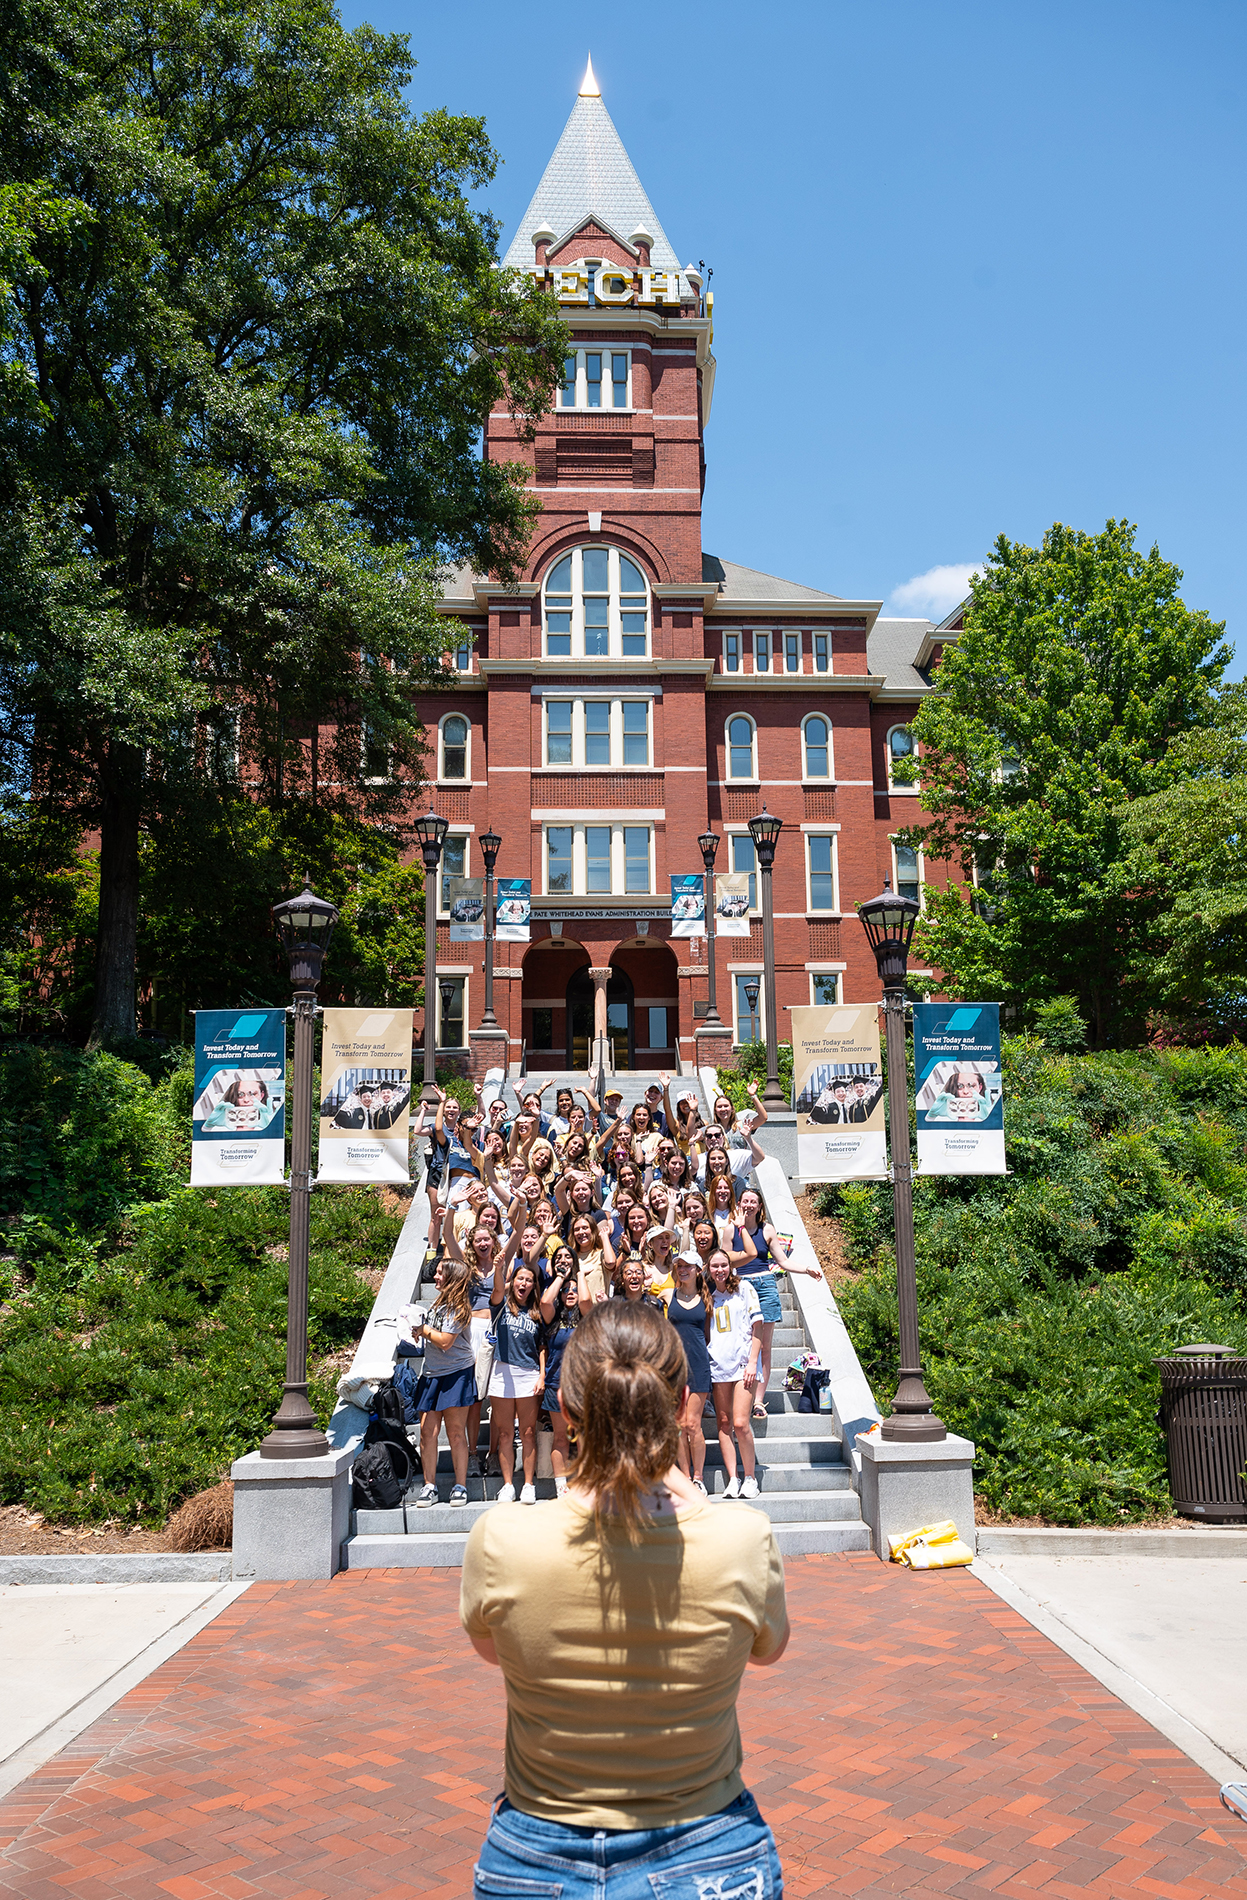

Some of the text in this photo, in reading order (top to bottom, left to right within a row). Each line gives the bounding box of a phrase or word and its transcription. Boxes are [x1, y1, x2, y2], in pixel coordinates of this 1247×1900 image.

[942, 1036, 962, 1044] Today
[203, 1044, 224, 1052] Invest
[225, 1044, 245, 1052] Today
